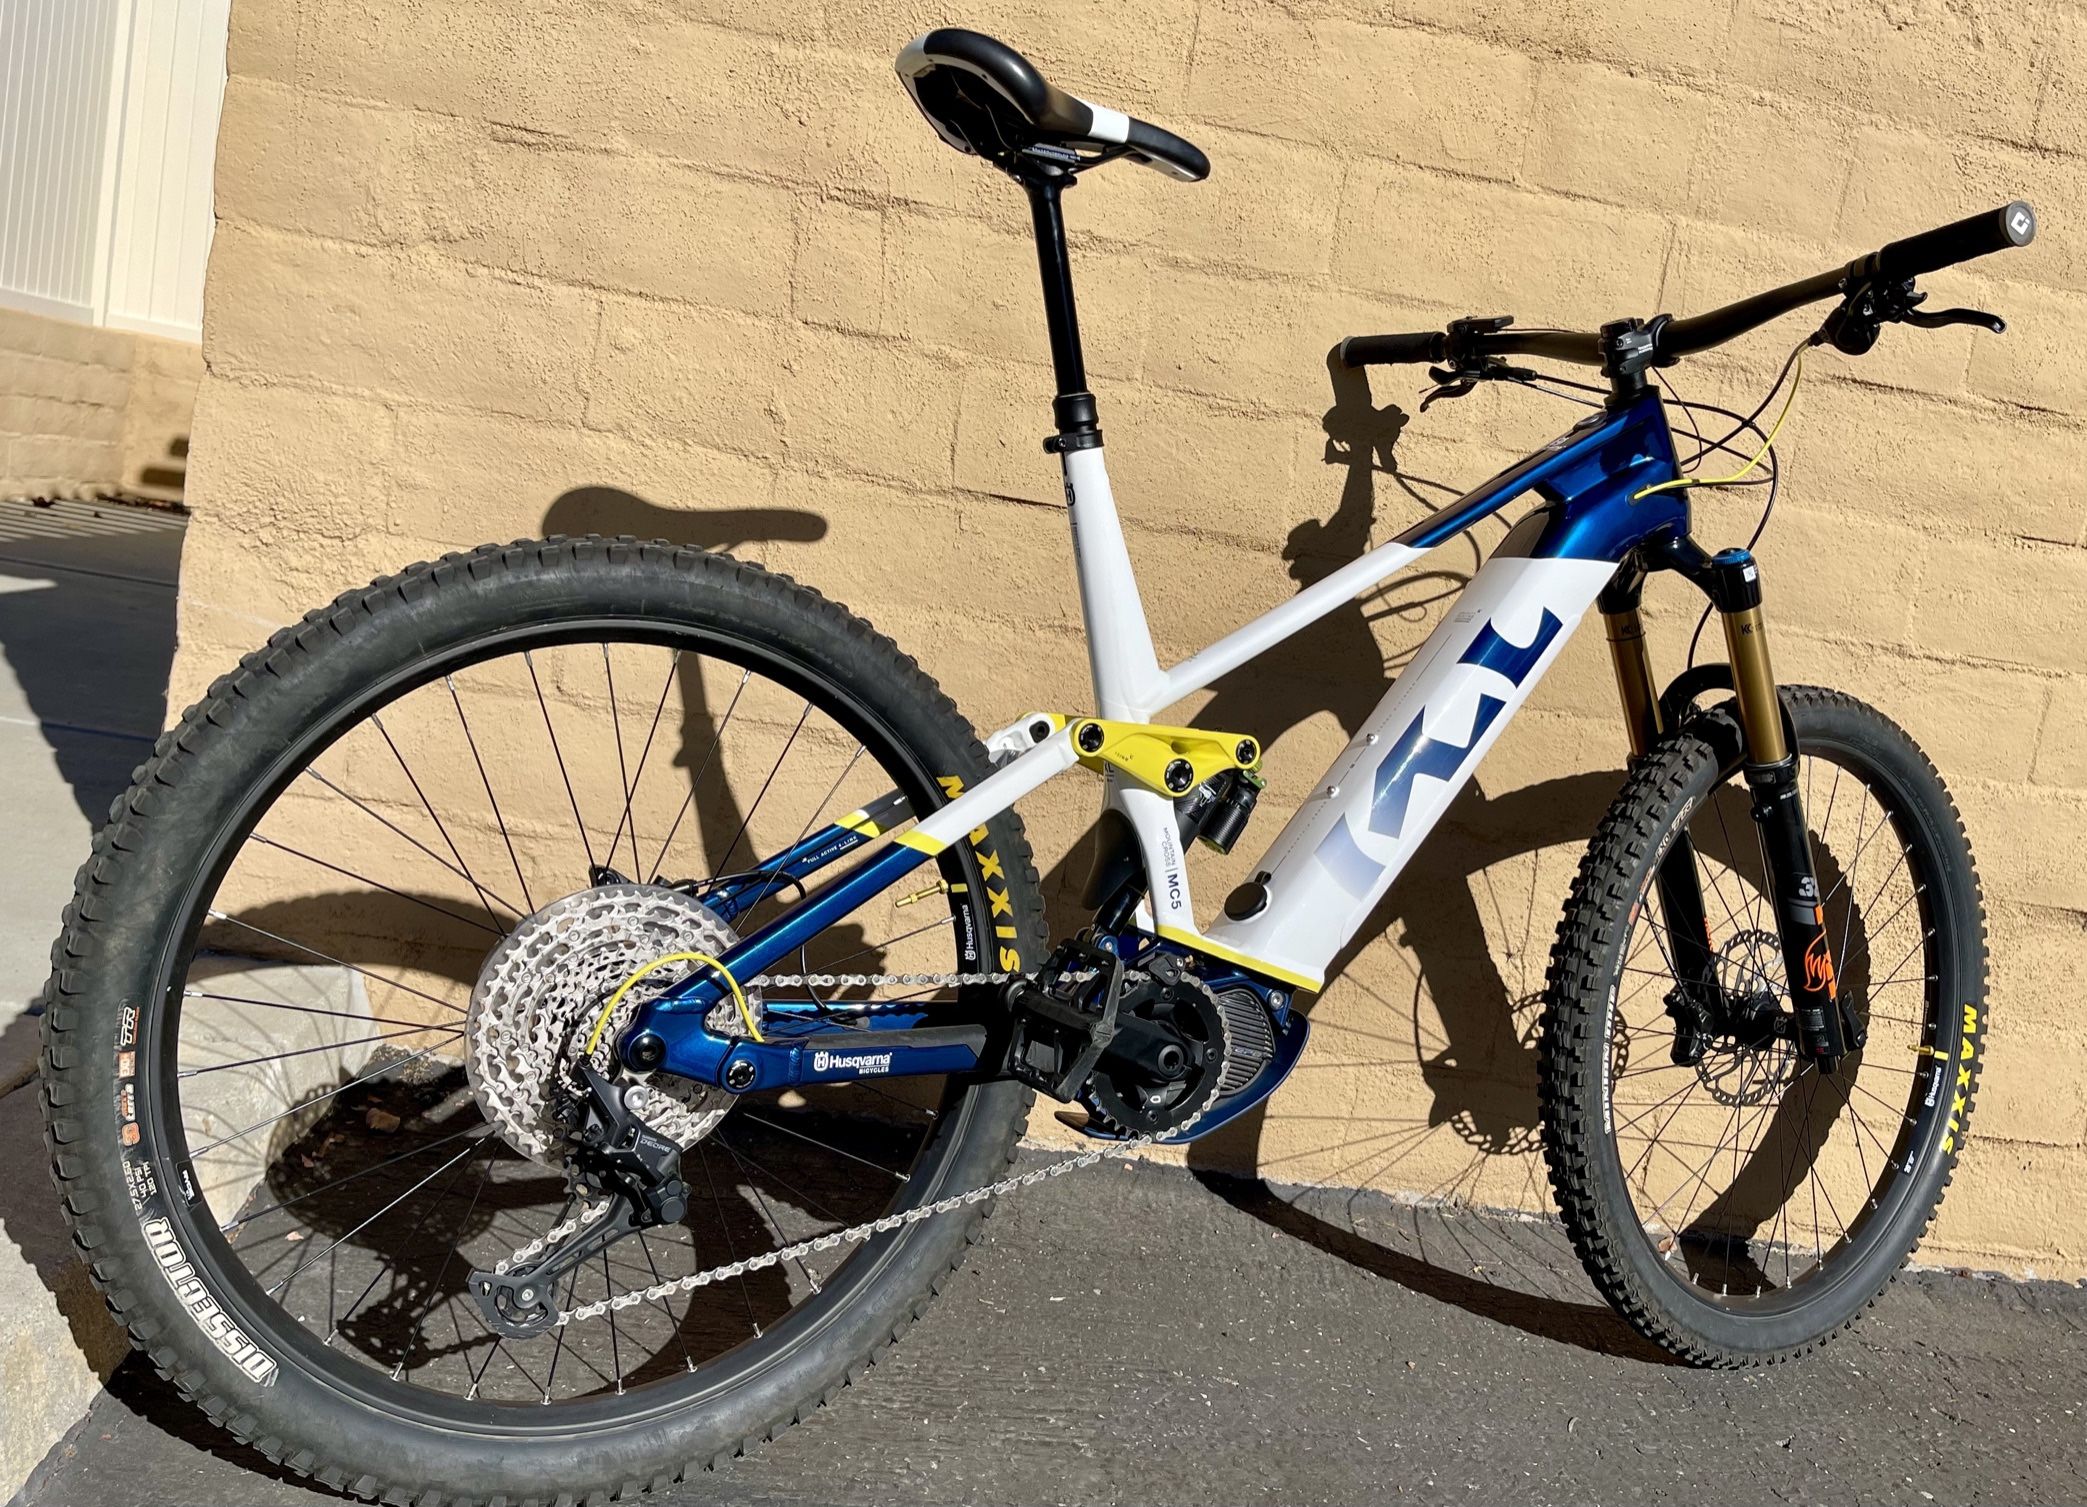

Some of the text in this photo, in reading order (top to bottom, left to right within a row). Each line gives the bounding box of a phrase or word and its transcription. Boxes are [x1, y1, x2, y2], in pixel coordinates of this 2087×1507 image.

[1162, 841, 1172, 867] CROSS
[1163, 827, 1176, 866] MOUNTAIN
[1168, 873, 1182, 910] MC5
[962, 904, 974, 950] Husqvarna
[120, 1006, 135, 1046] TR
[829, 1052, 893, 1068] Husqvarna
[858, 1066, 889, 1075] BICYCLES
[1940, 1004, 1978, 1155] MAXXIS
[640, 1139, 672, 1153] DEORE
[134, 1167, 147, 1198] 40 PSI
[142, 1218, 279, 1384] DISSECTOR
